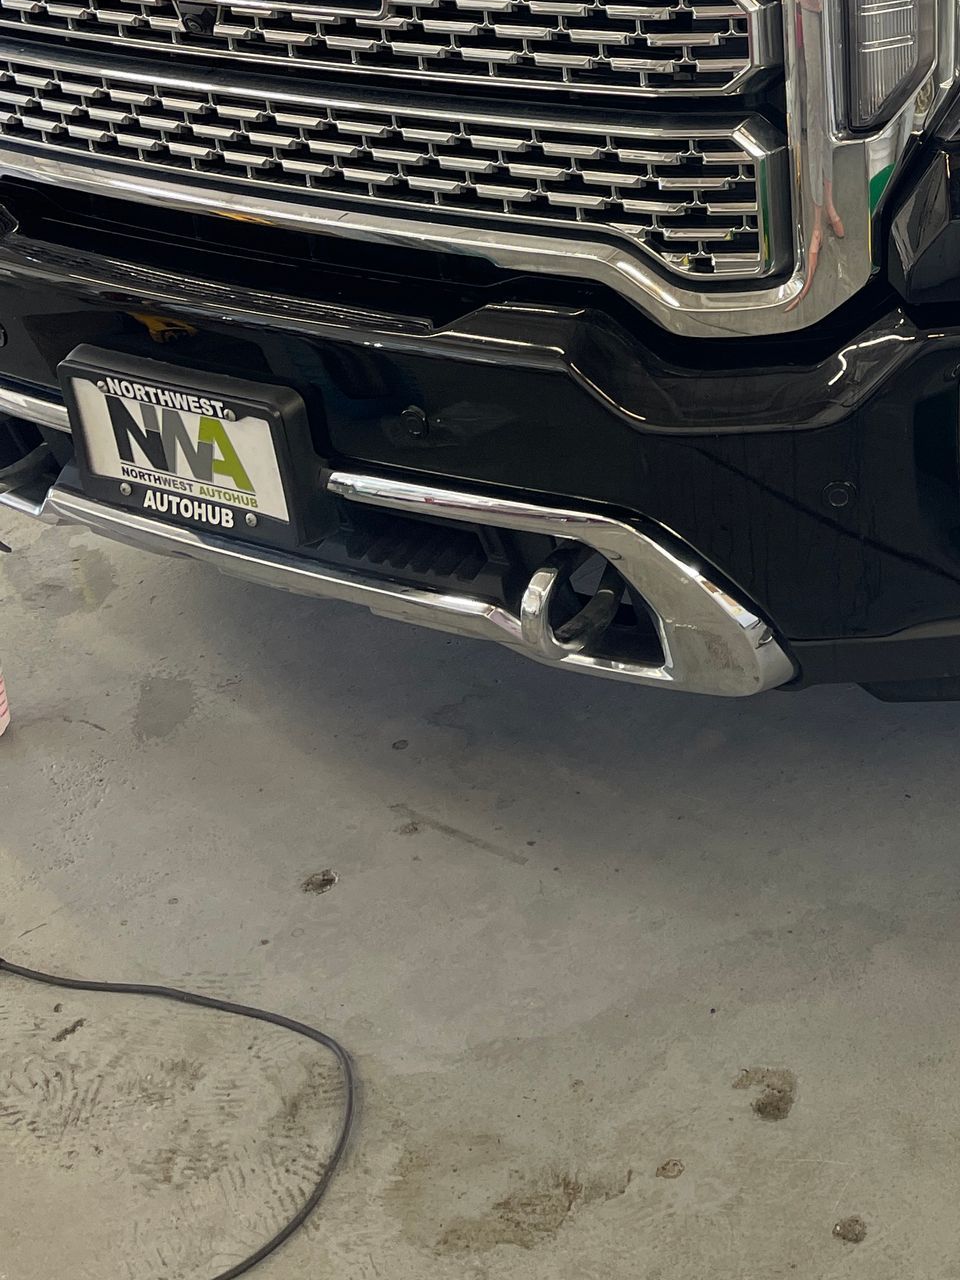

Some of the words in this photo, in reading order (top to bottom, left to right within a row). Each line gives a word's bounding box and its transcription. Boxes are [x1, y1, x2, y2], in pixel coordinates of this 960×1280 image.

[105, 376, 225, 419] NORTHWEST
[121, 465, 194, 494] NORTHWEST
[199, 486, 259, 509] AUTOHUB
[143, 489, 235, 529] AUTOHUB
